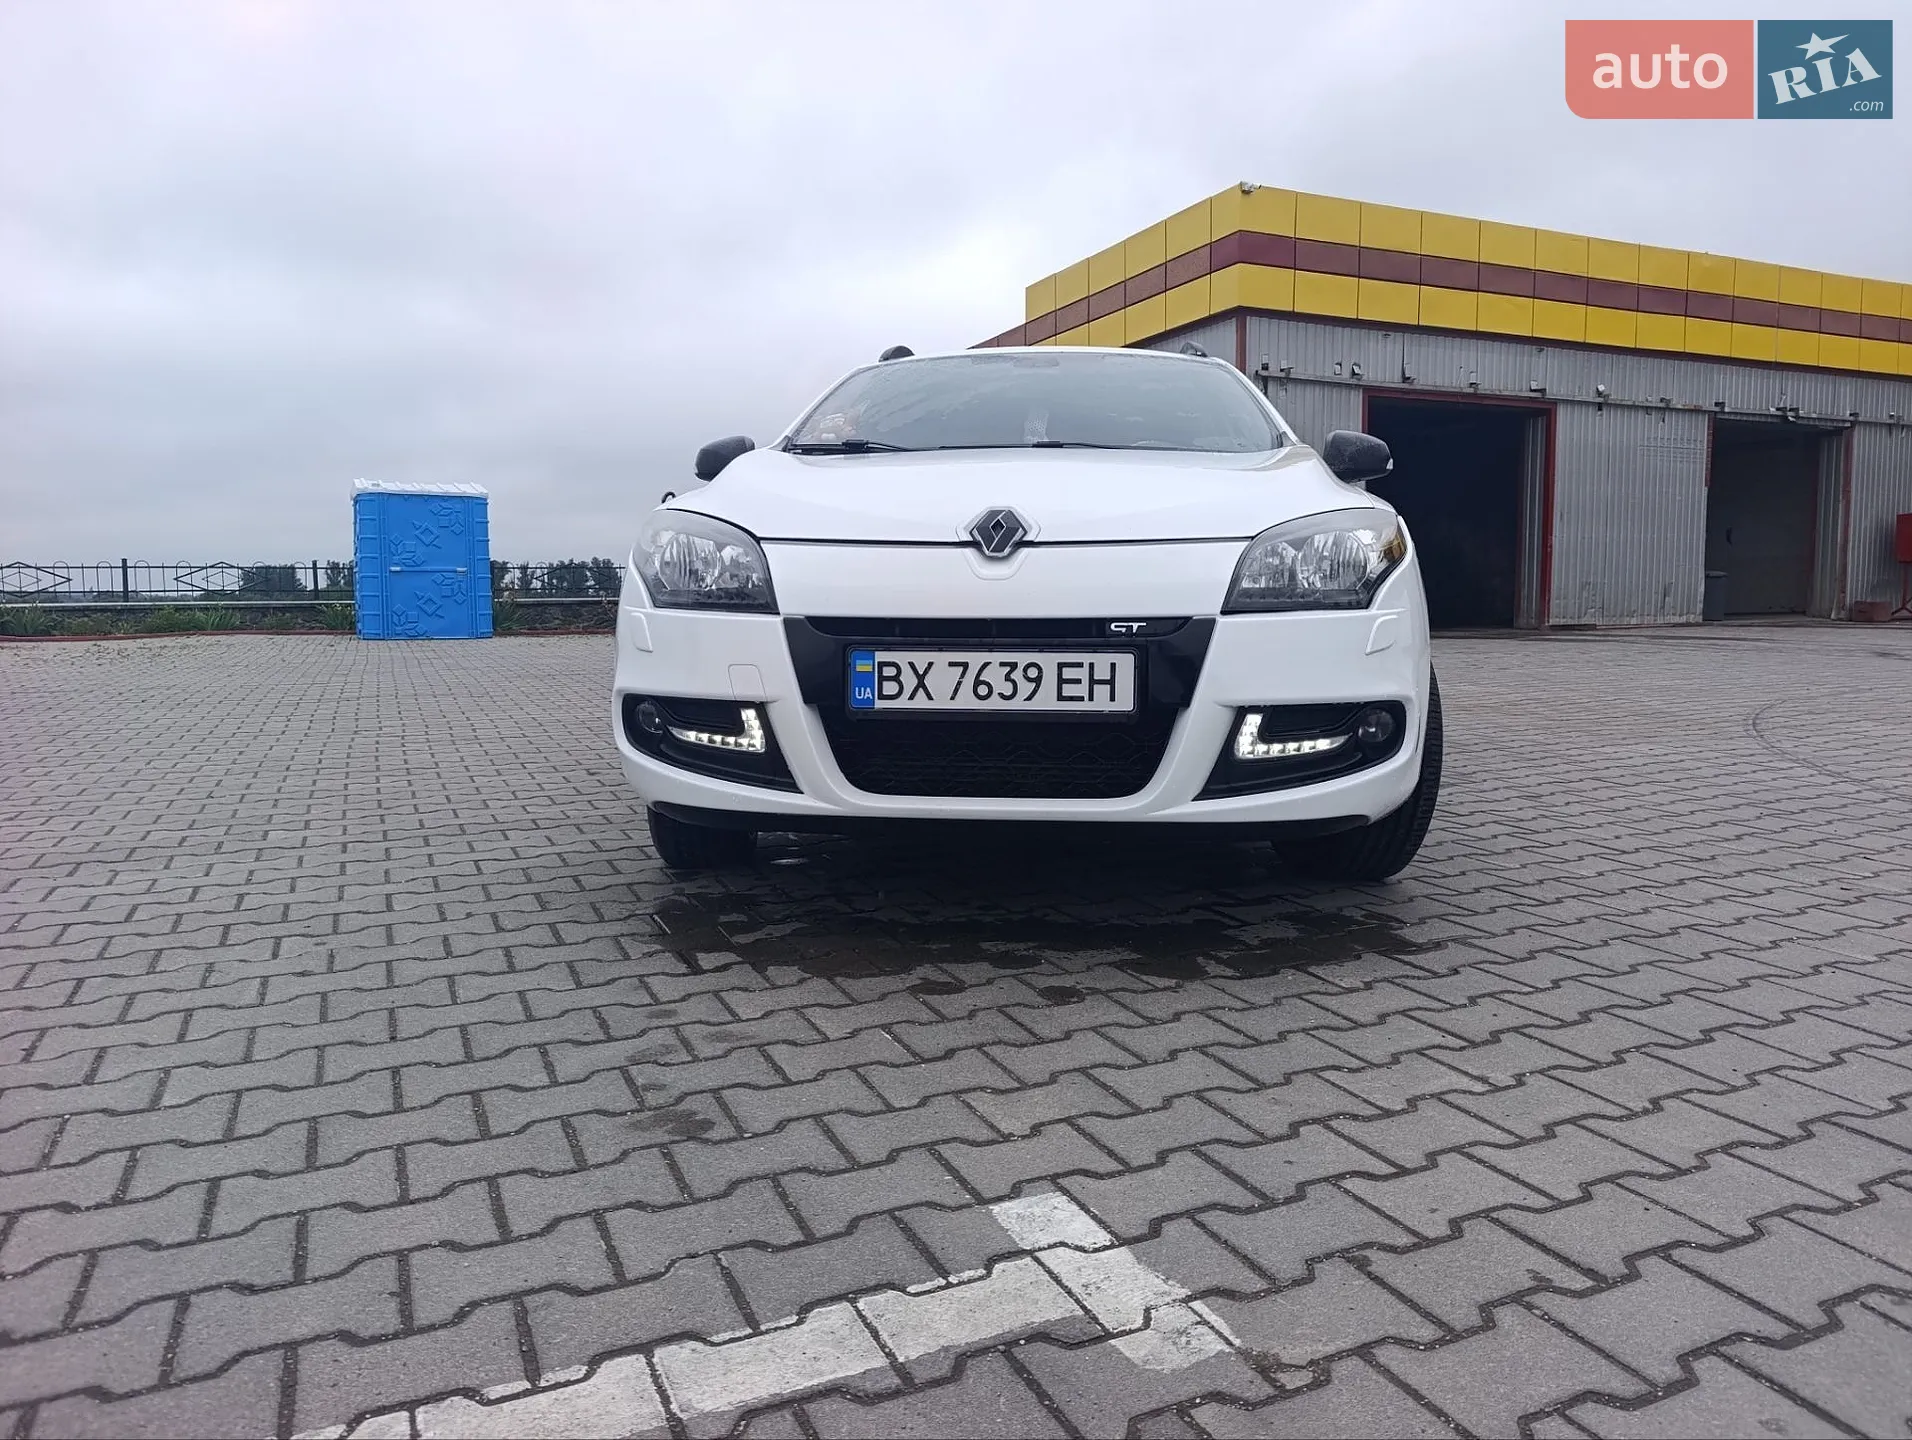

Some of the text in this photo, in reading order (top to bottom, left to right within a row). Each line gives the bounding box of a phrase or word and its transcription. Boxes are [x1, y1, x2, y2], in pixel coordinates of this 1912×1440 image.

[855, 687, 873, 700] UA
[876, 660, 1117, 703] BX 7639 EH
